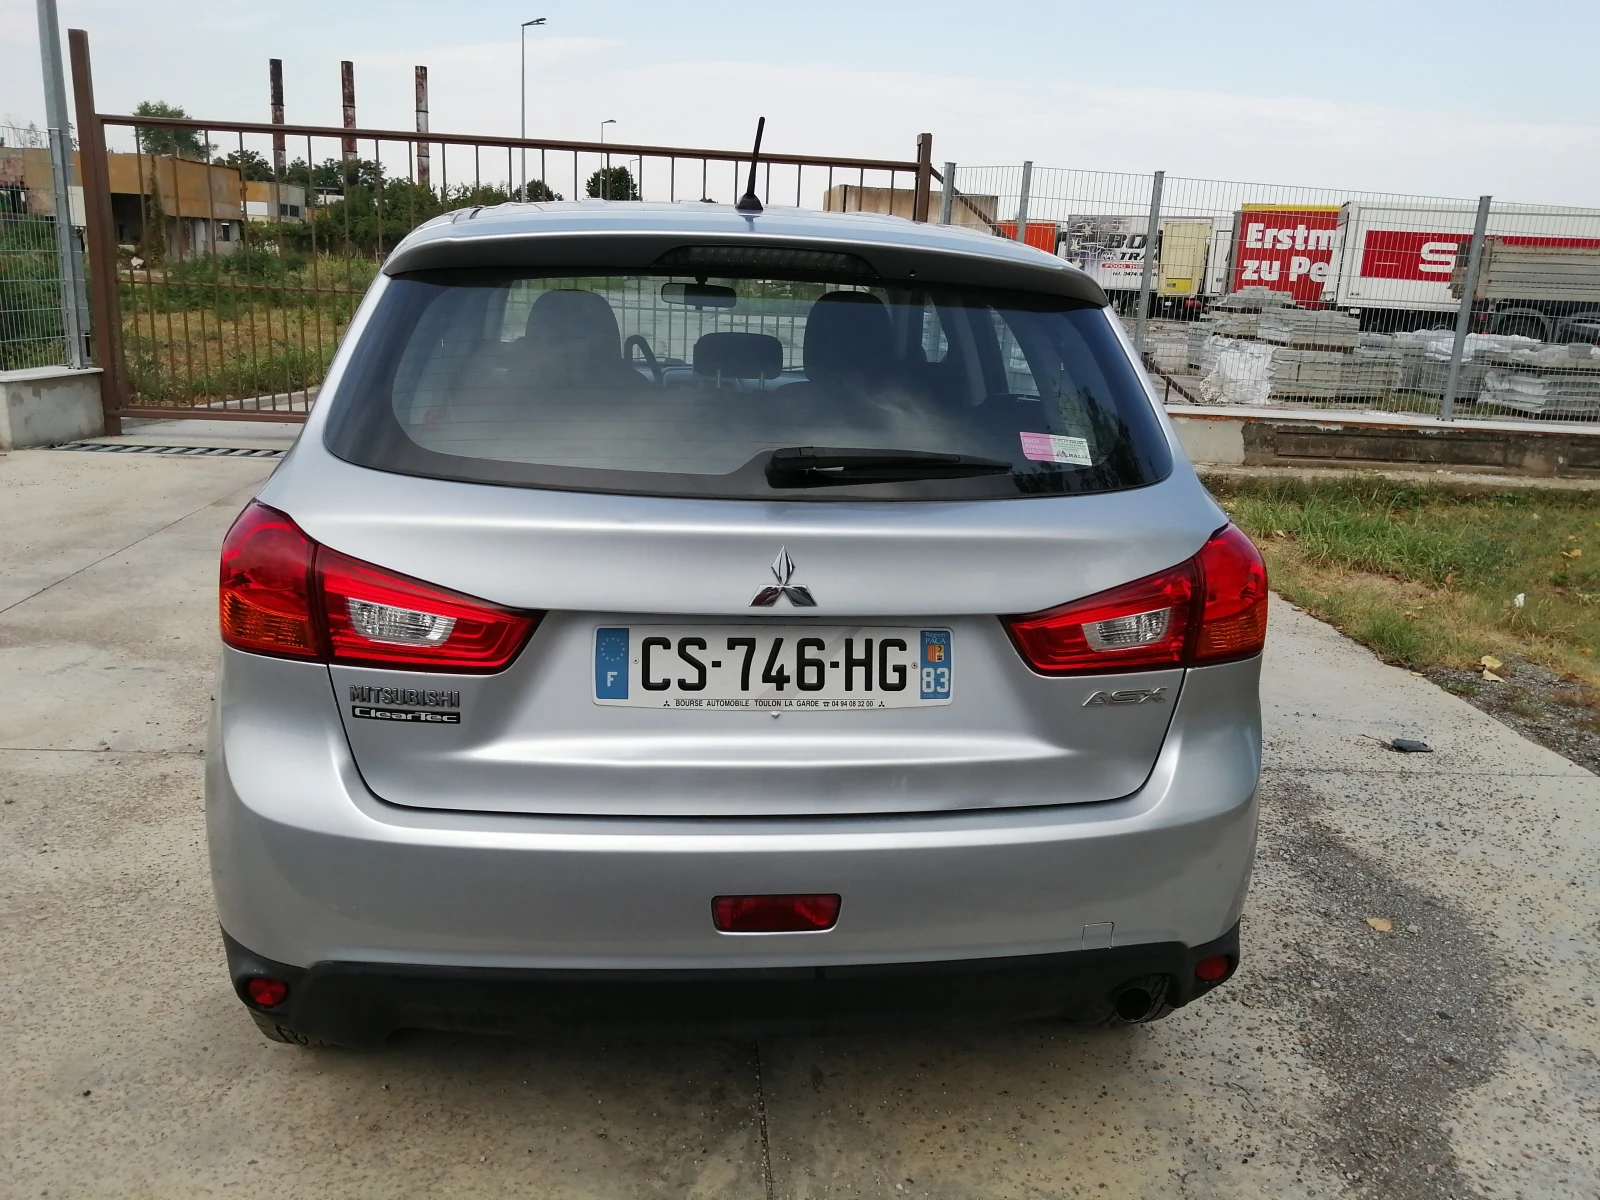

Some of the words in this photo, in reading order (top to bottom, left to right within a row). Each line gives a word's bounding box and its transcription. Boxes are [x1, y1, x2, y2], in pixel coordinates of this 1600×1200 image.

[1241, 260, 1280, 281] zu
[641, 636, 908, 692] CS-746-HG
[606, 671, 618, 687] F
[922, 667, 949, 693] 83
[349, 685, 460, 707] MITSUBISHI
[675, 699, 703, 707] BOURSE
[706, 699, 750, 707] AUTOMOBILE
[754, 699, 782, 707] TOULON
[784, 699, 793, 707] LA
[1082, 686, 1168, 708] ASX
[354, 707, 457, 722] ClearTec
